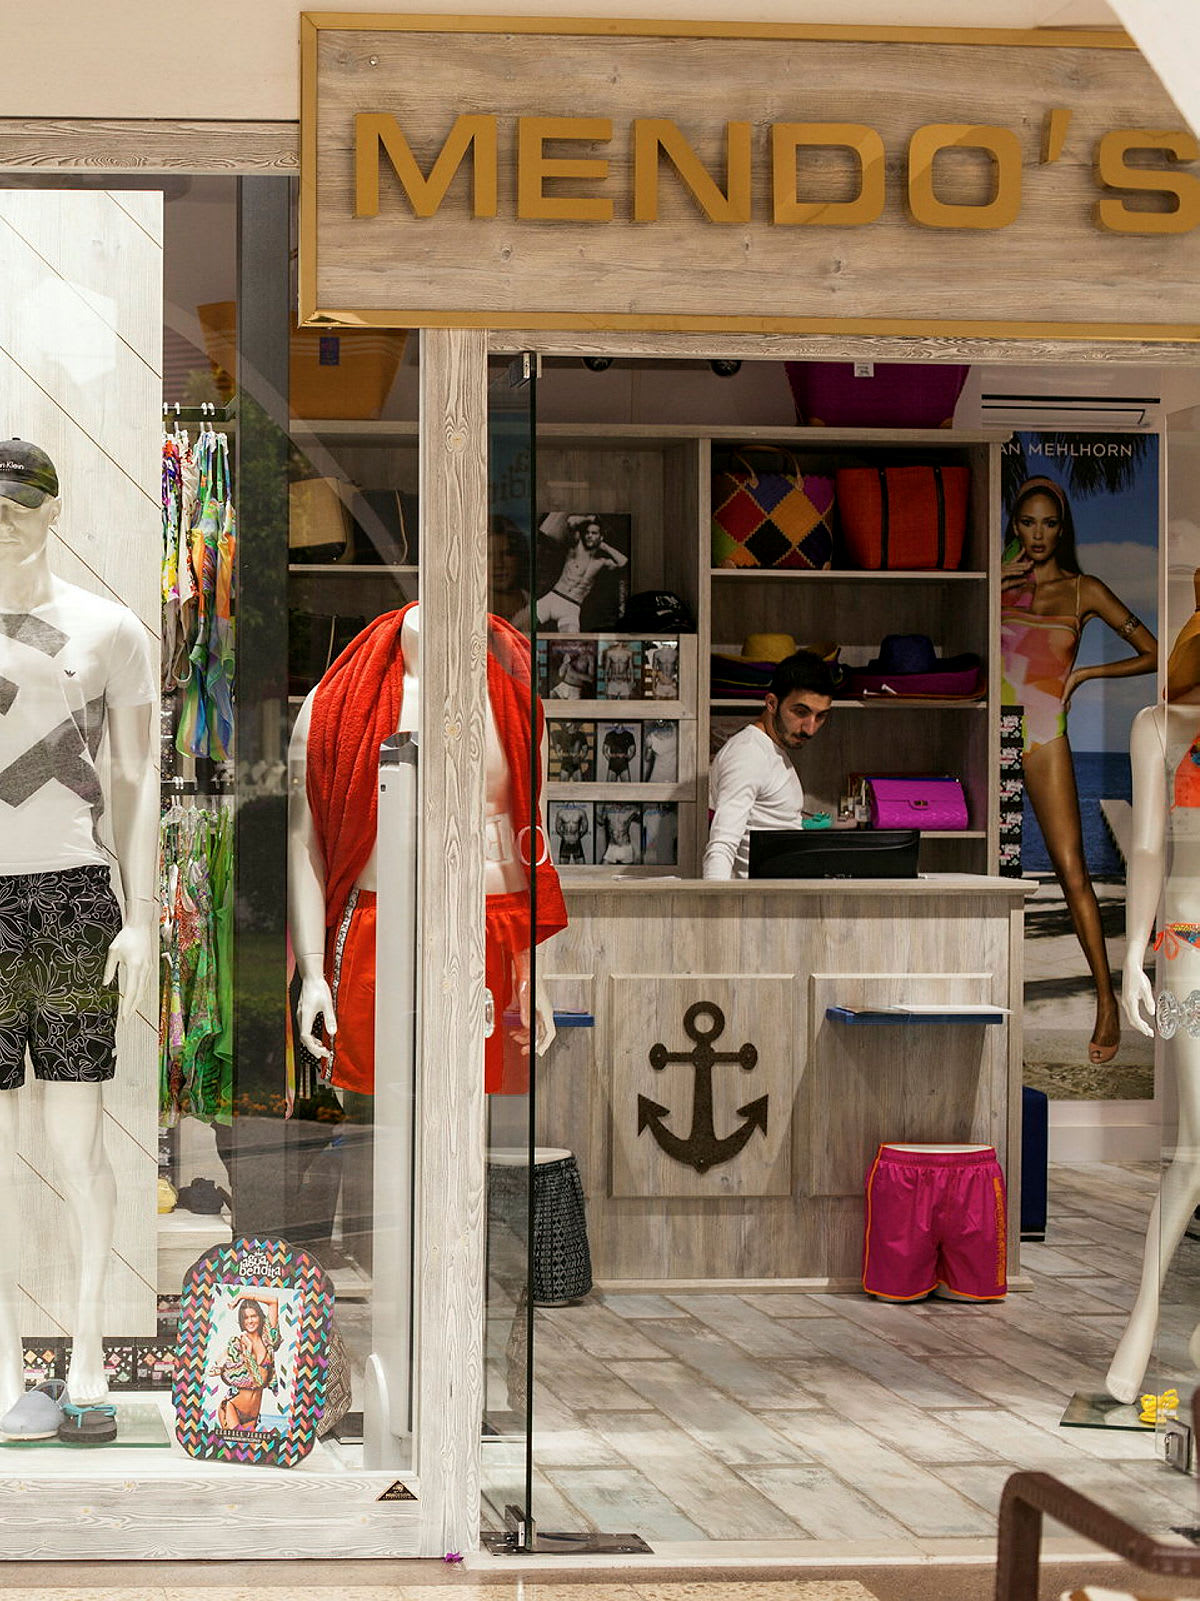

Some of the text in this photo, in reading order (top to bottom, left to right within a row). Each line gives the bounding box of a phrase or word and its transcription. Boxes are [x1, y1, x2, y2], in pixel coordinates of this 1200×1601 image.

[353, 109, 1200, 234] MENDO'S
[1028, 443, 1133, 457] MEHLHORN
[239, 1260, 281, 1278] bendita
